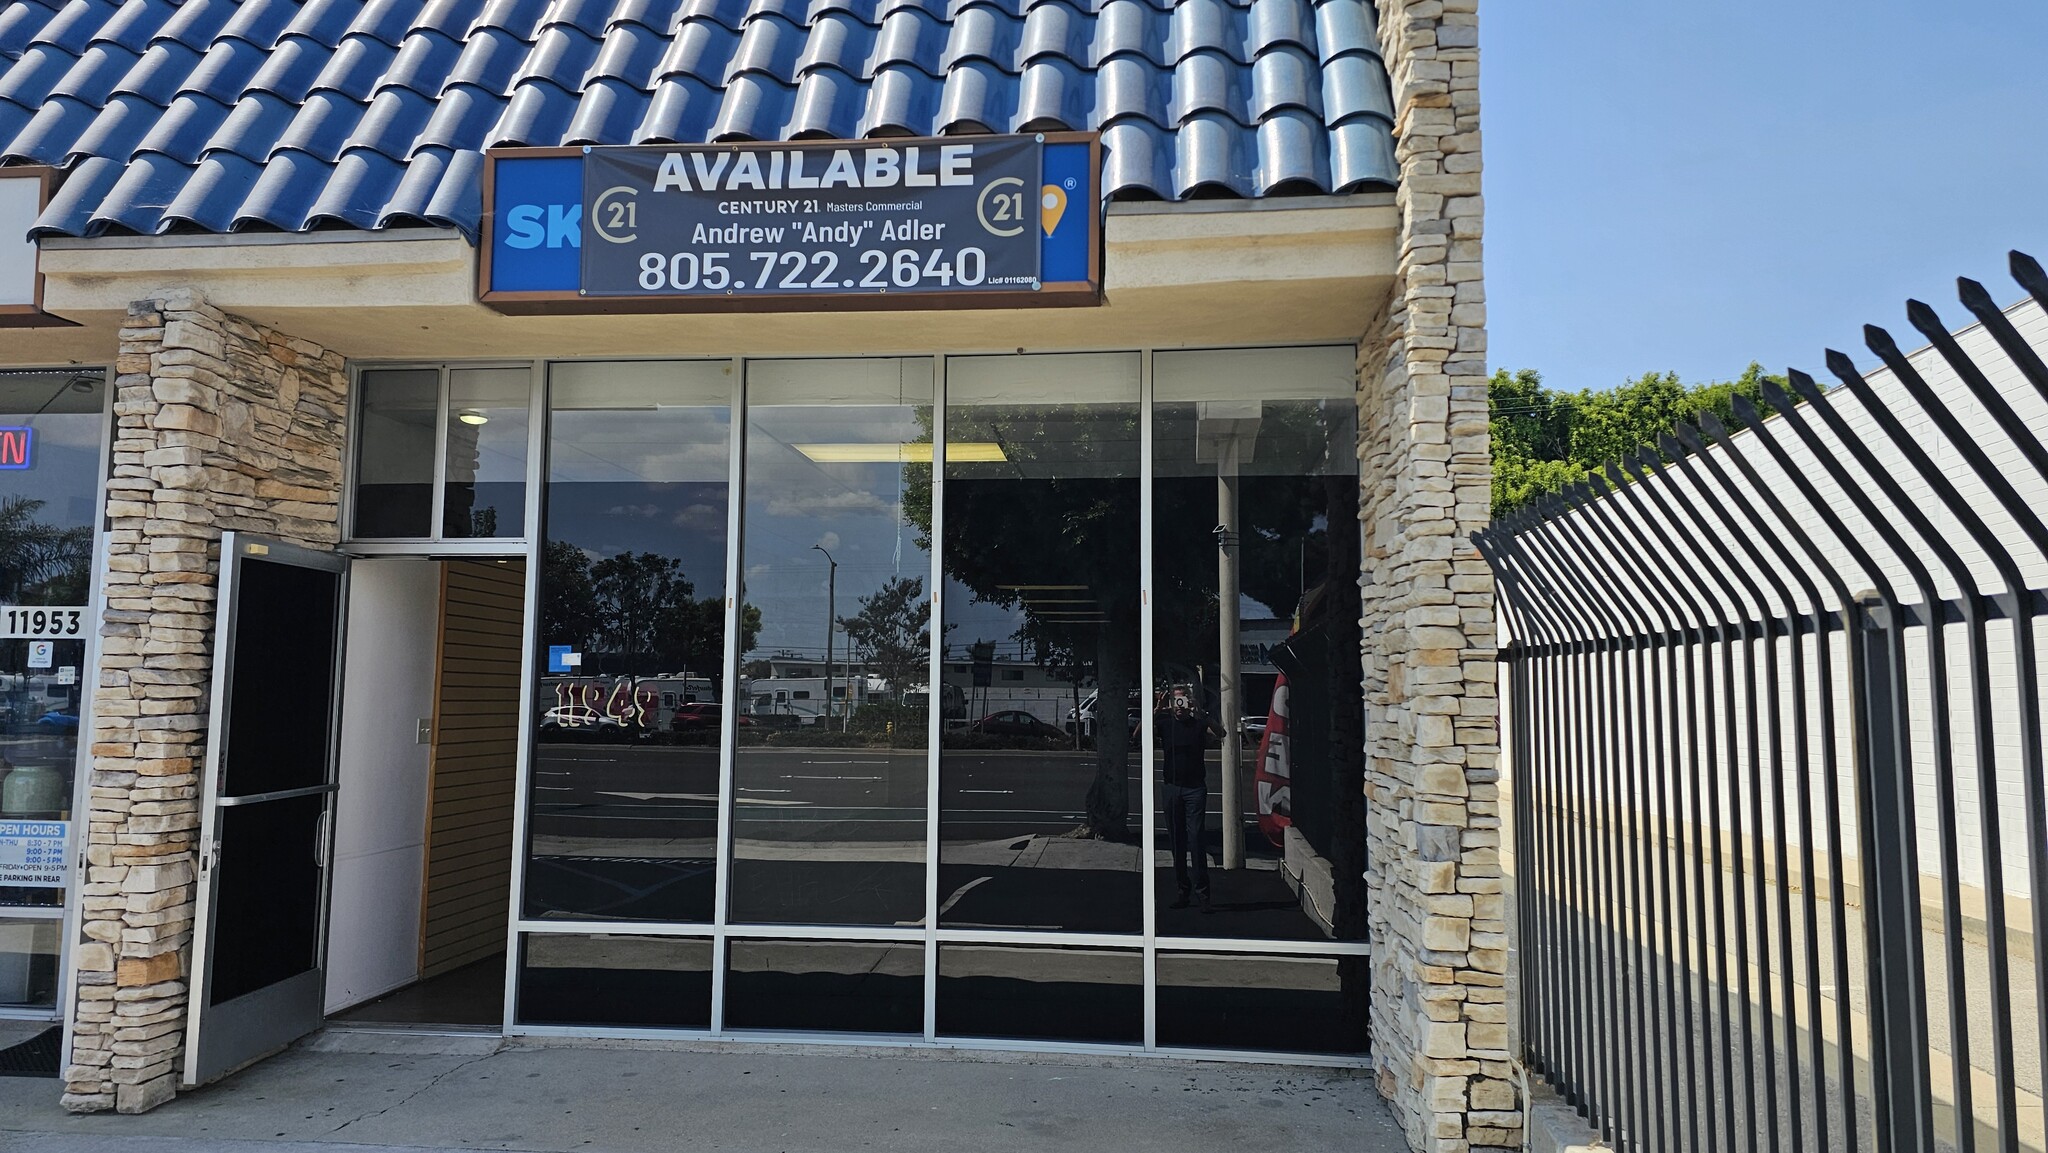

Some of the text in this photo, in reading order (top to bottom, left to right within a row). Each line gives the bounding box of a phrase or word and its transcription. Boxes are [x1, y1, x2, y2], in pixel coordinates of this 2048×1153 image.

[653, 144, 974, 193] AVAILABLE
[718, 199, 923, 214] CENTURY 21 Masters Commercial
[691, 219, 946, 248] Andrew "Andy" Adler
[638, 247, 986, 290] 805.722.2640
[8, 610, 80, 635] 11953
[0, 824, 61, 836] PEN HOURS
[4, 874, 33, 882] PARKING
